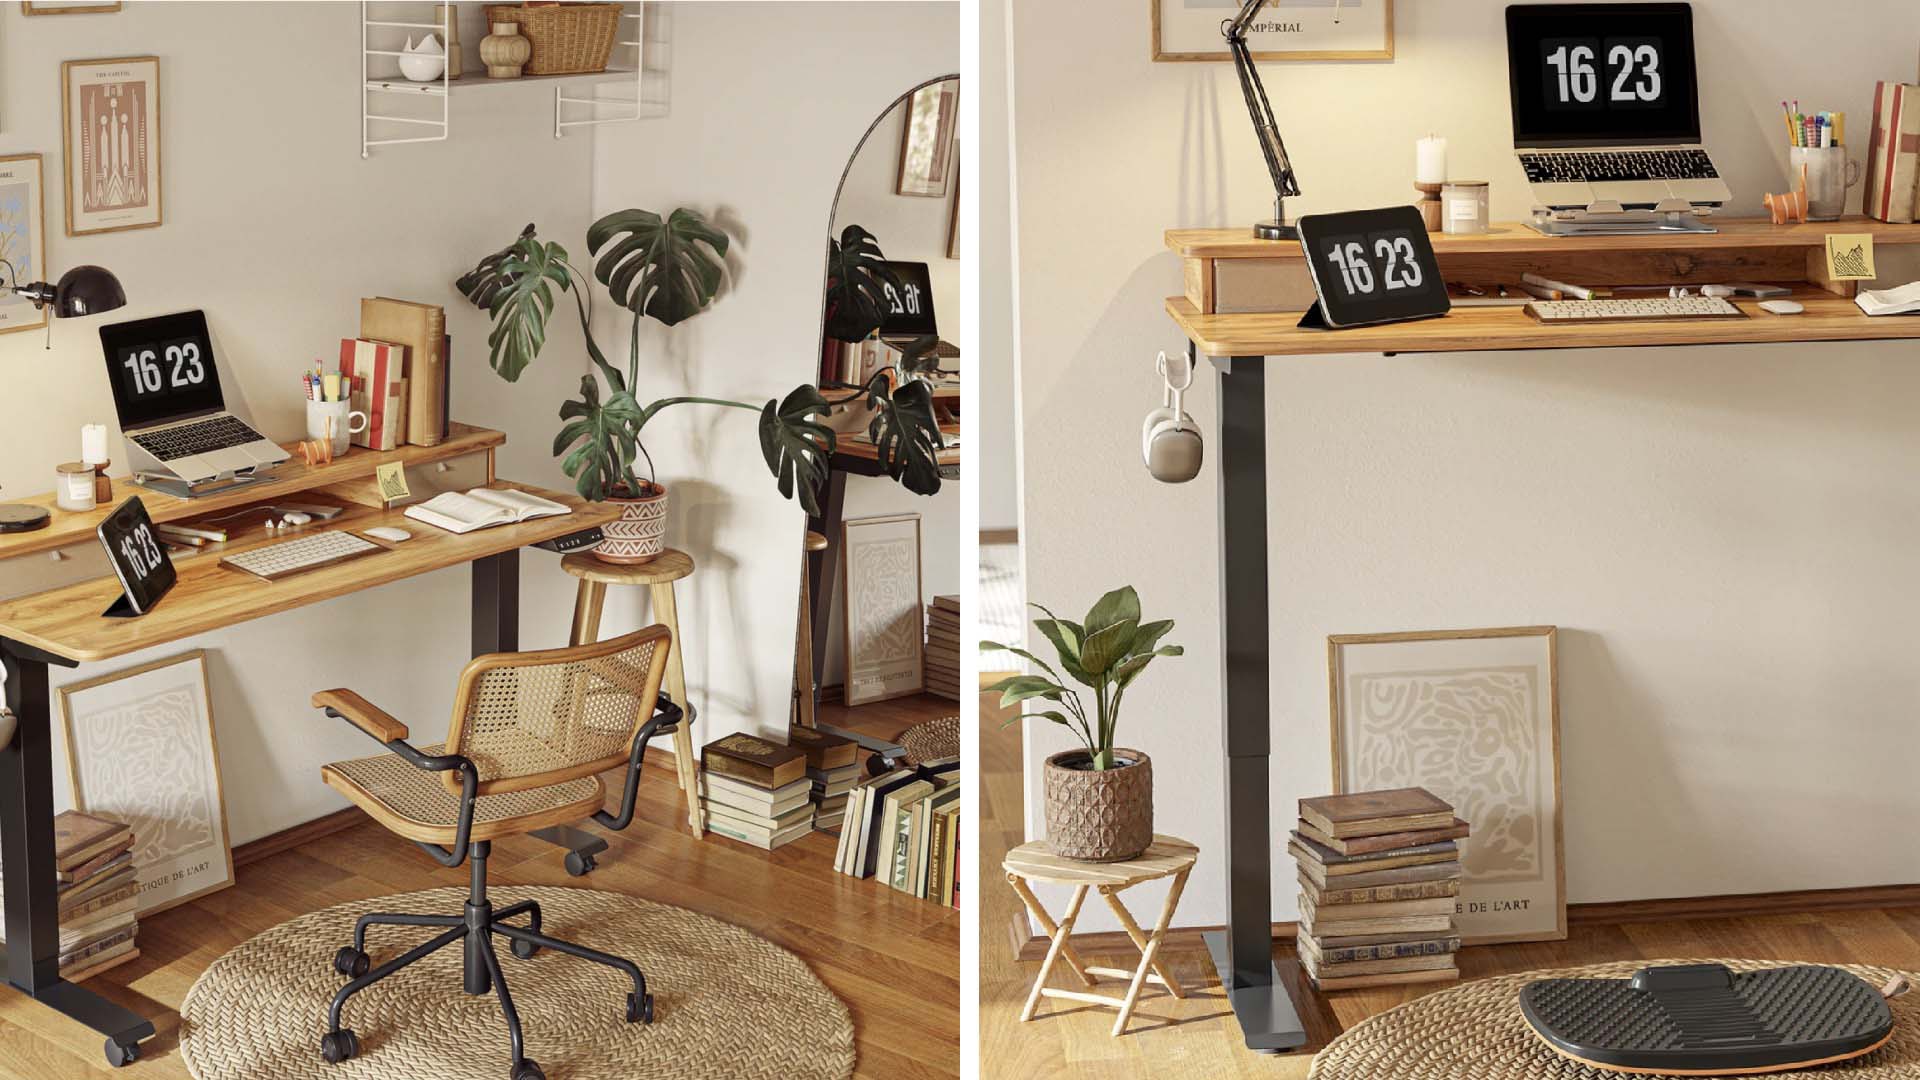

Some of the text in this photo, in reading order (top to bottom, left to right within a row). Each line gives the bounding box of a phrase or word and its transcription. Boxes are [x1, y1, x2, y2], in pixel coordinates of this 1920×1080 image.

[1249, 21, 1304, 33] MPÉRIAL
[1546, 45, 1661, 102] 16 23
[1328, 237, 1422, 295] 16 23
[124, 342, 204, 394] 16 23
[121, 523, 161, 580] 16 23
[142, 861, 210, 892] TIQUE DE L'ART
[1469, 902, 1487, 913] DE
[1493, 899, 1530, 912] L'ART
